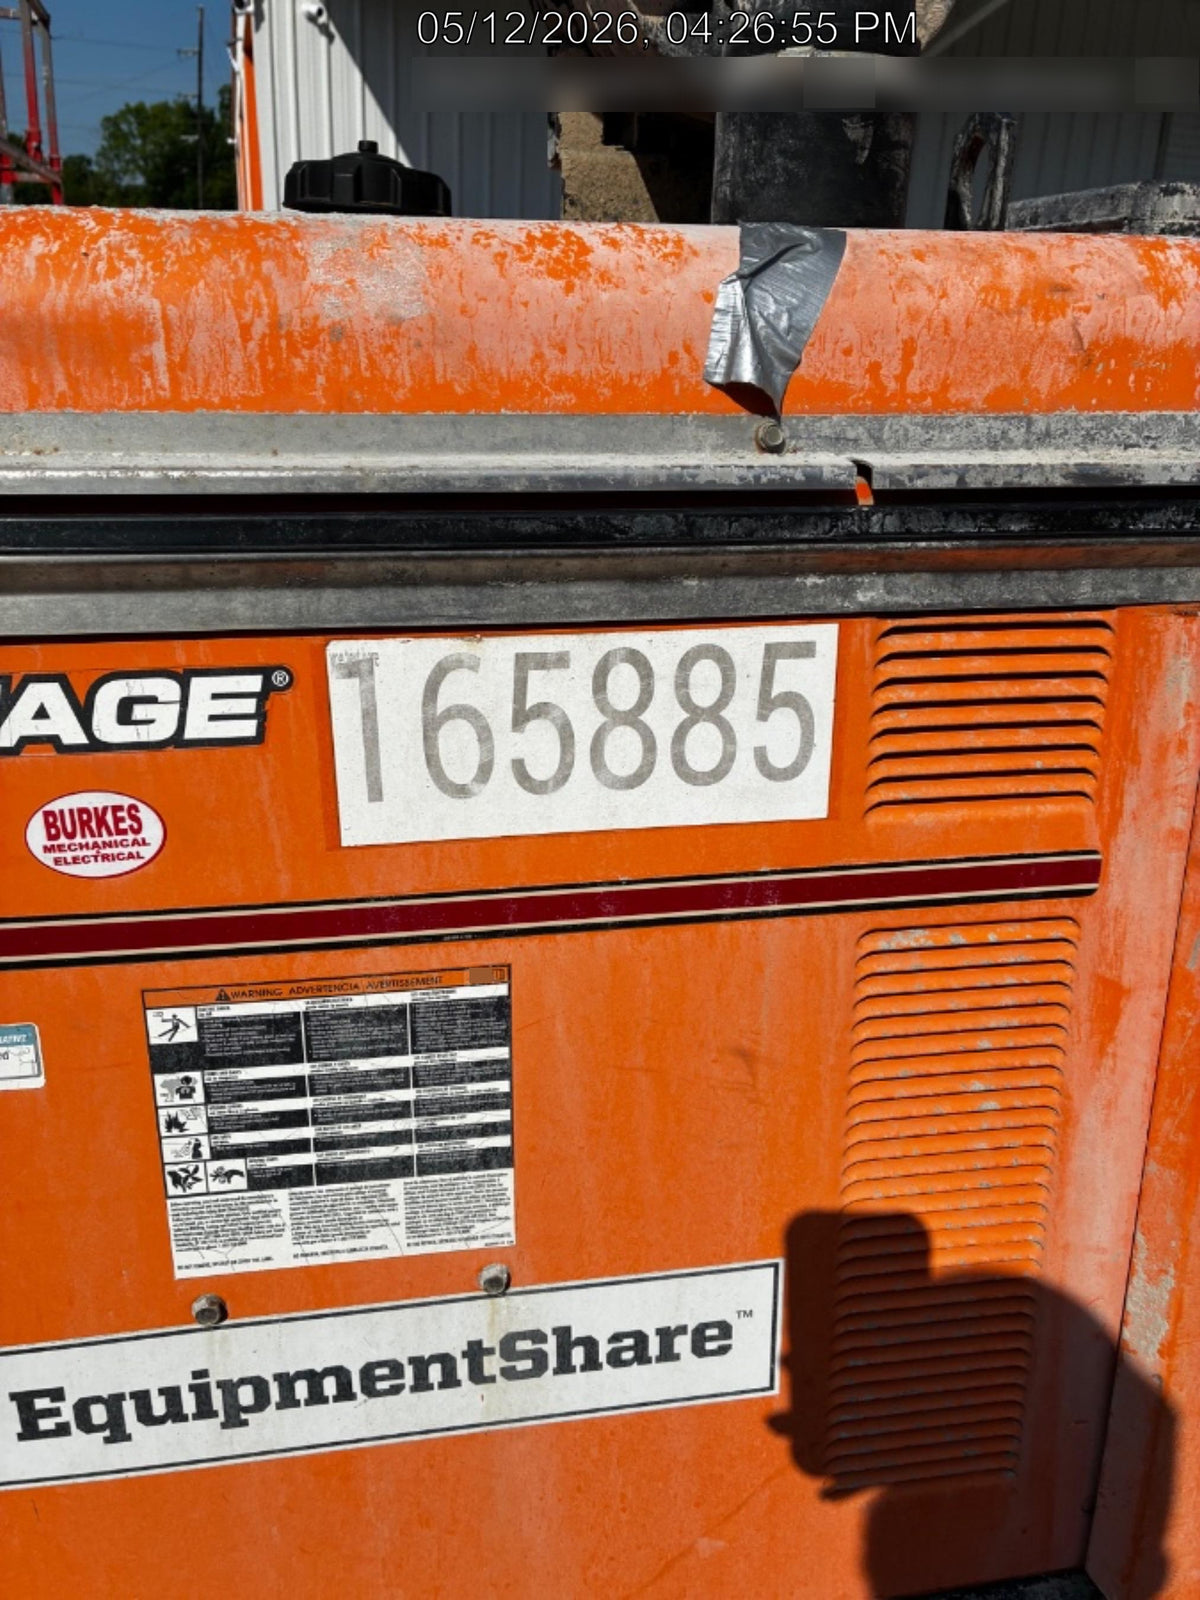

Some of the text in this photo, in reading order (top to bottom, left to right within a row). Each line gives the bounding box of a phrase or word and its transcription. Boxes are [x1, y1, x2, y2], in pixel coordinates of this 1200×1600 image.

[0, 669, 290, 748] AGE®
[332, 640, 817, 802] 165885
[42, 803, 143, 841] BURKES
[42, 837, 151, 854] MECHANICAL
[53, 851, 146, 866] ELECTRICAL
[230, 975, 444, 1000] WARNING ADVERTENCIA AVERTISSEMENT
